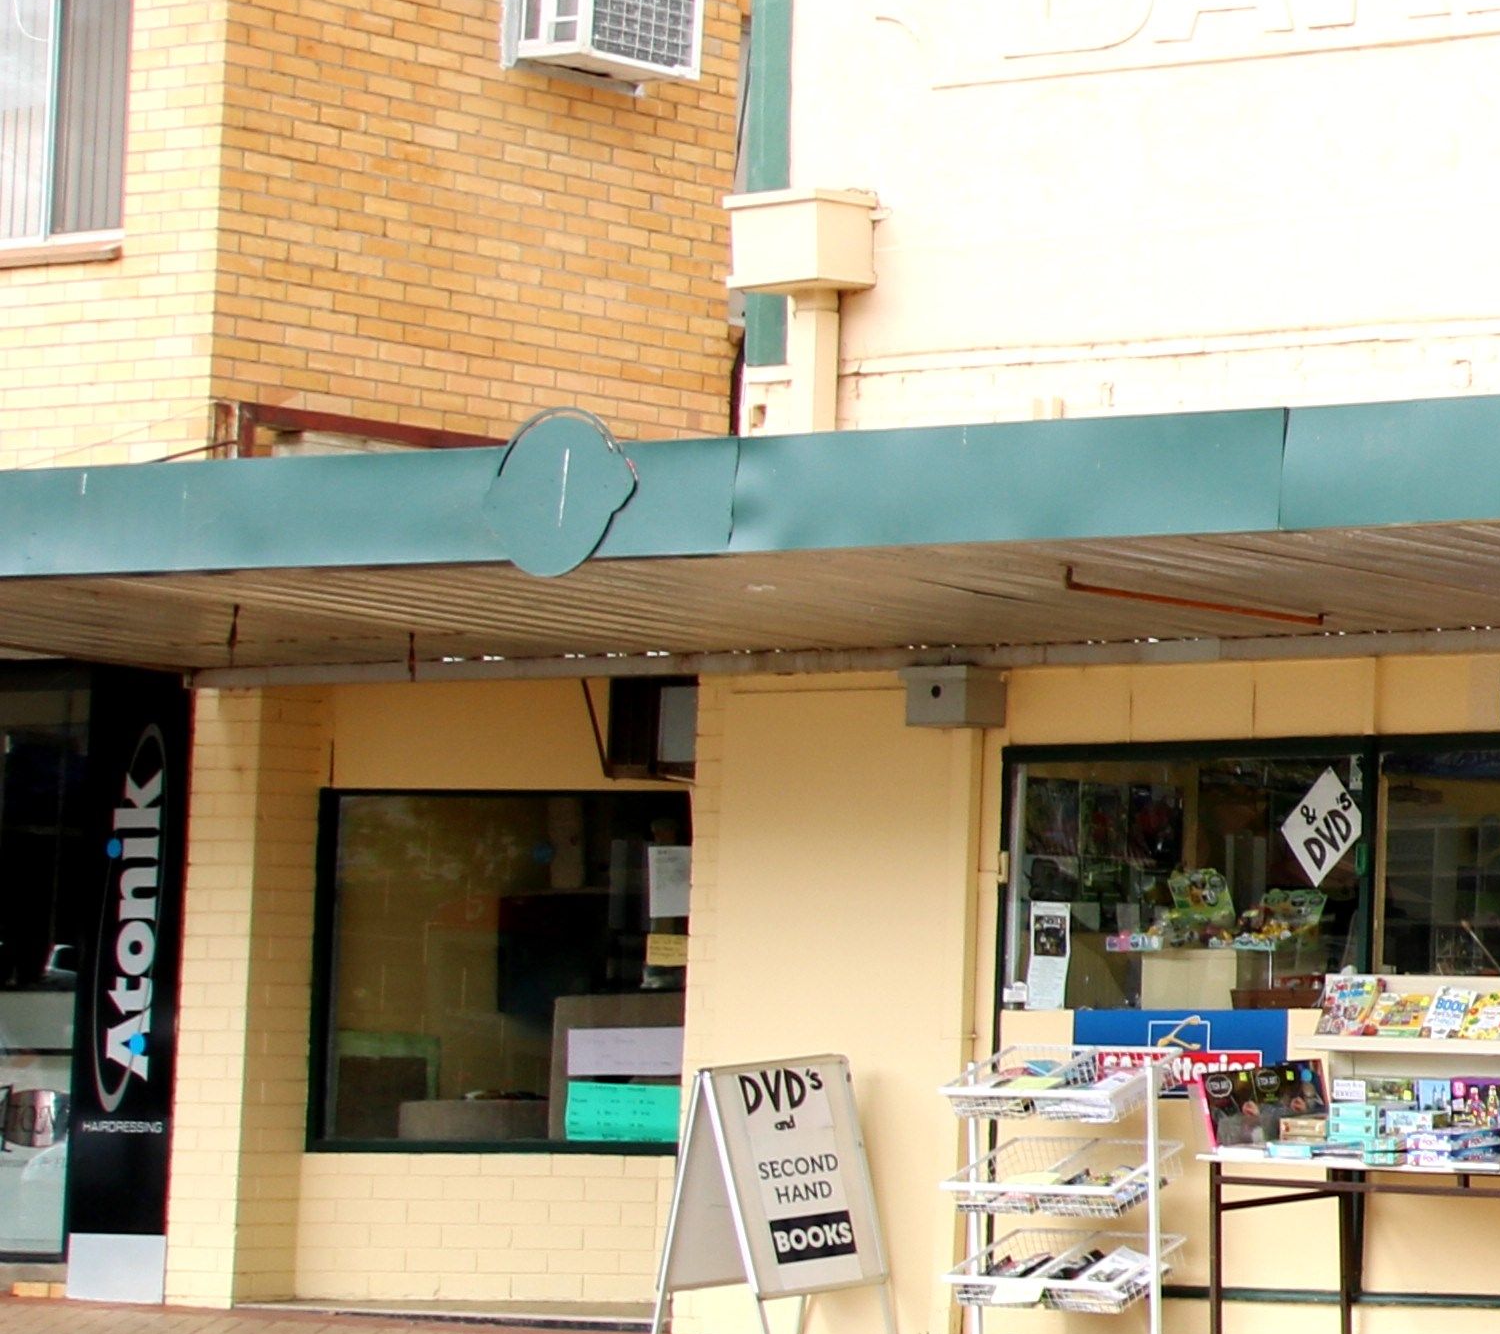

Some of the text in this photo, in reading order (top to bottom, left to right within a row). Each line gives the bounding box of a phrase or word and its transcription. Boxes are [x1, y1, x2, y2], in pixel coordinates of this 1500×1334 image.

[105, 768, 165, 1082] Atonik
[738, 1068, 824, 1116] DVD's
[82, 1120, 163, 1135] HAIRDRESSING
[774, 1114, 796, 1131] and
[758, 1153, 839, 1181] SECOND
[775, 1180, 833, 1205] HAND
[773, 1223, 852, 1254] BOOKS
